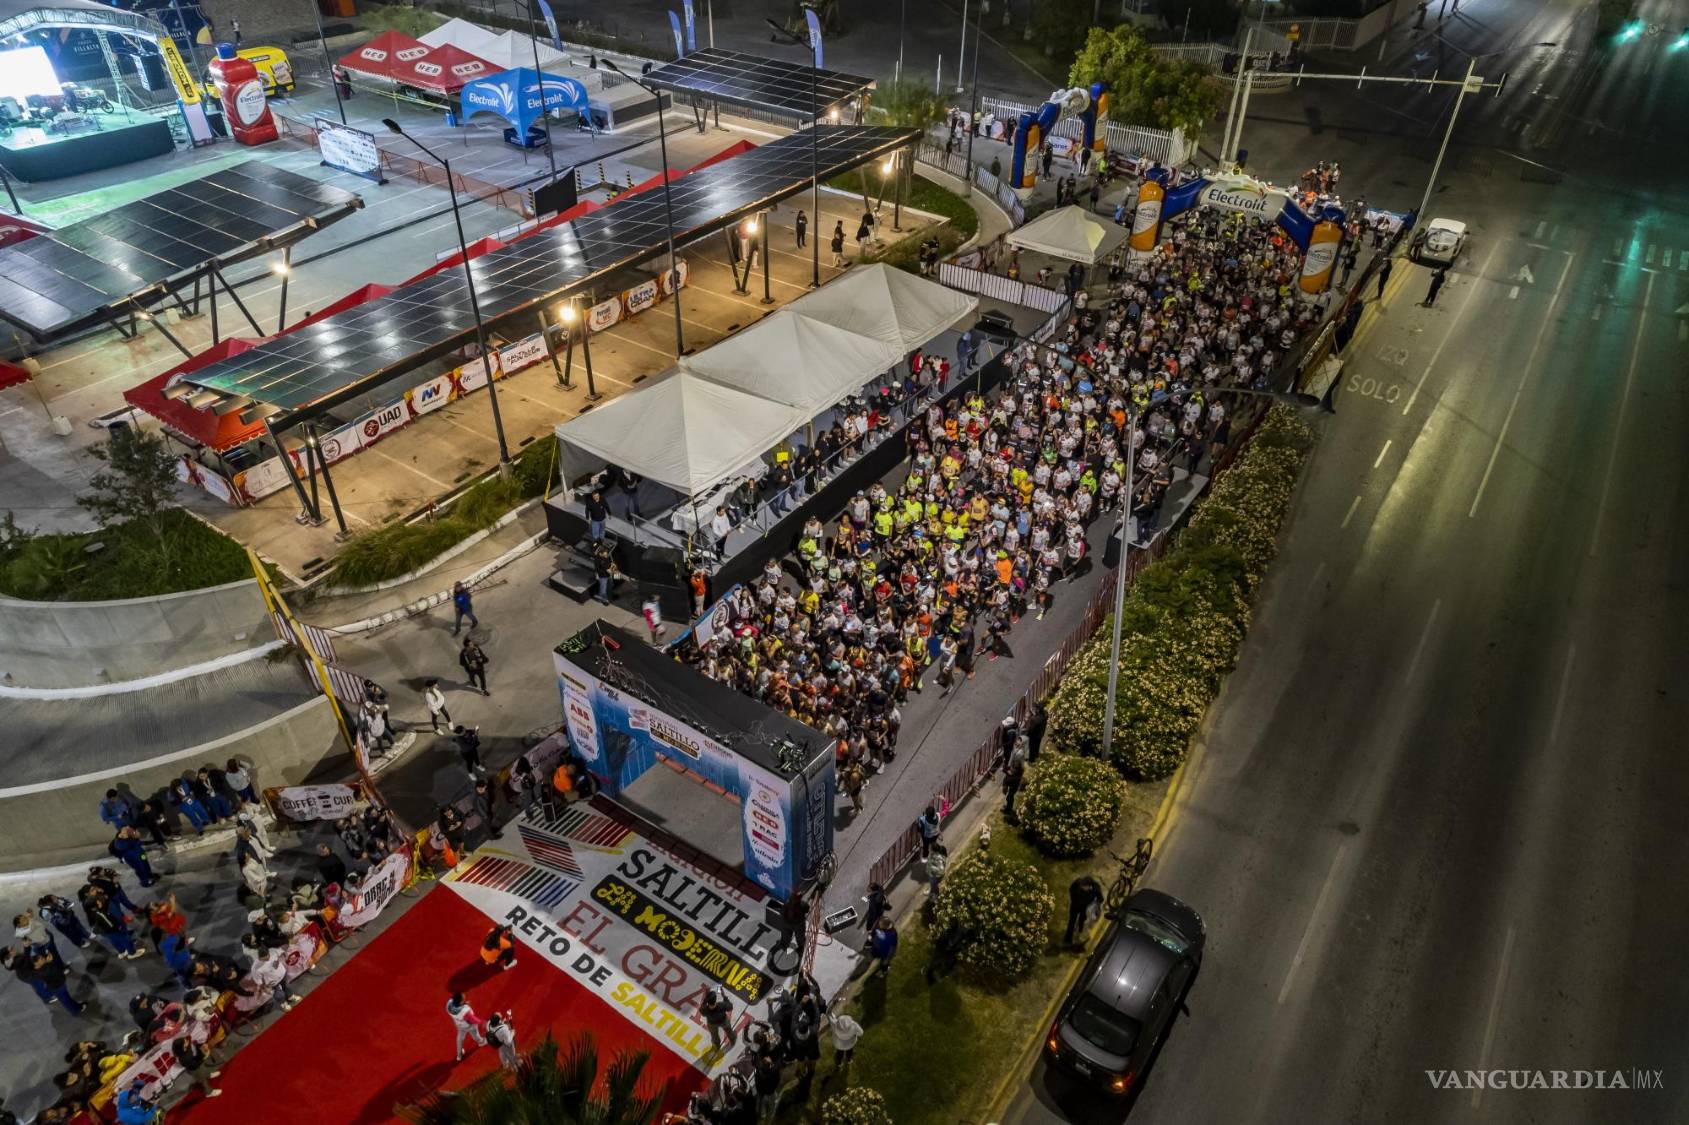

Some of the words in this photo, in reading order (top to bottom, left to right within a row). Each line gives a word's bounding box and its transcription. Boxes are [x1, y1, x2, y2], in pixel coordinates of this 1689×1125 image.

[469, 92, 499, 108] Electrolit
[1208, 188, 1269, 212] Electrolit
[1346, 374, 1400, 403] SOLO
[649, 718, 700, 751] SALTILLO
[556, 900, 614, 956] EL
[616, 849, 801, 977] SALTILLO
[504, 905, 571, 956] RETO
[571, 953, 613, 987] DE
[634, 905, 762, 1001] MODERNA
